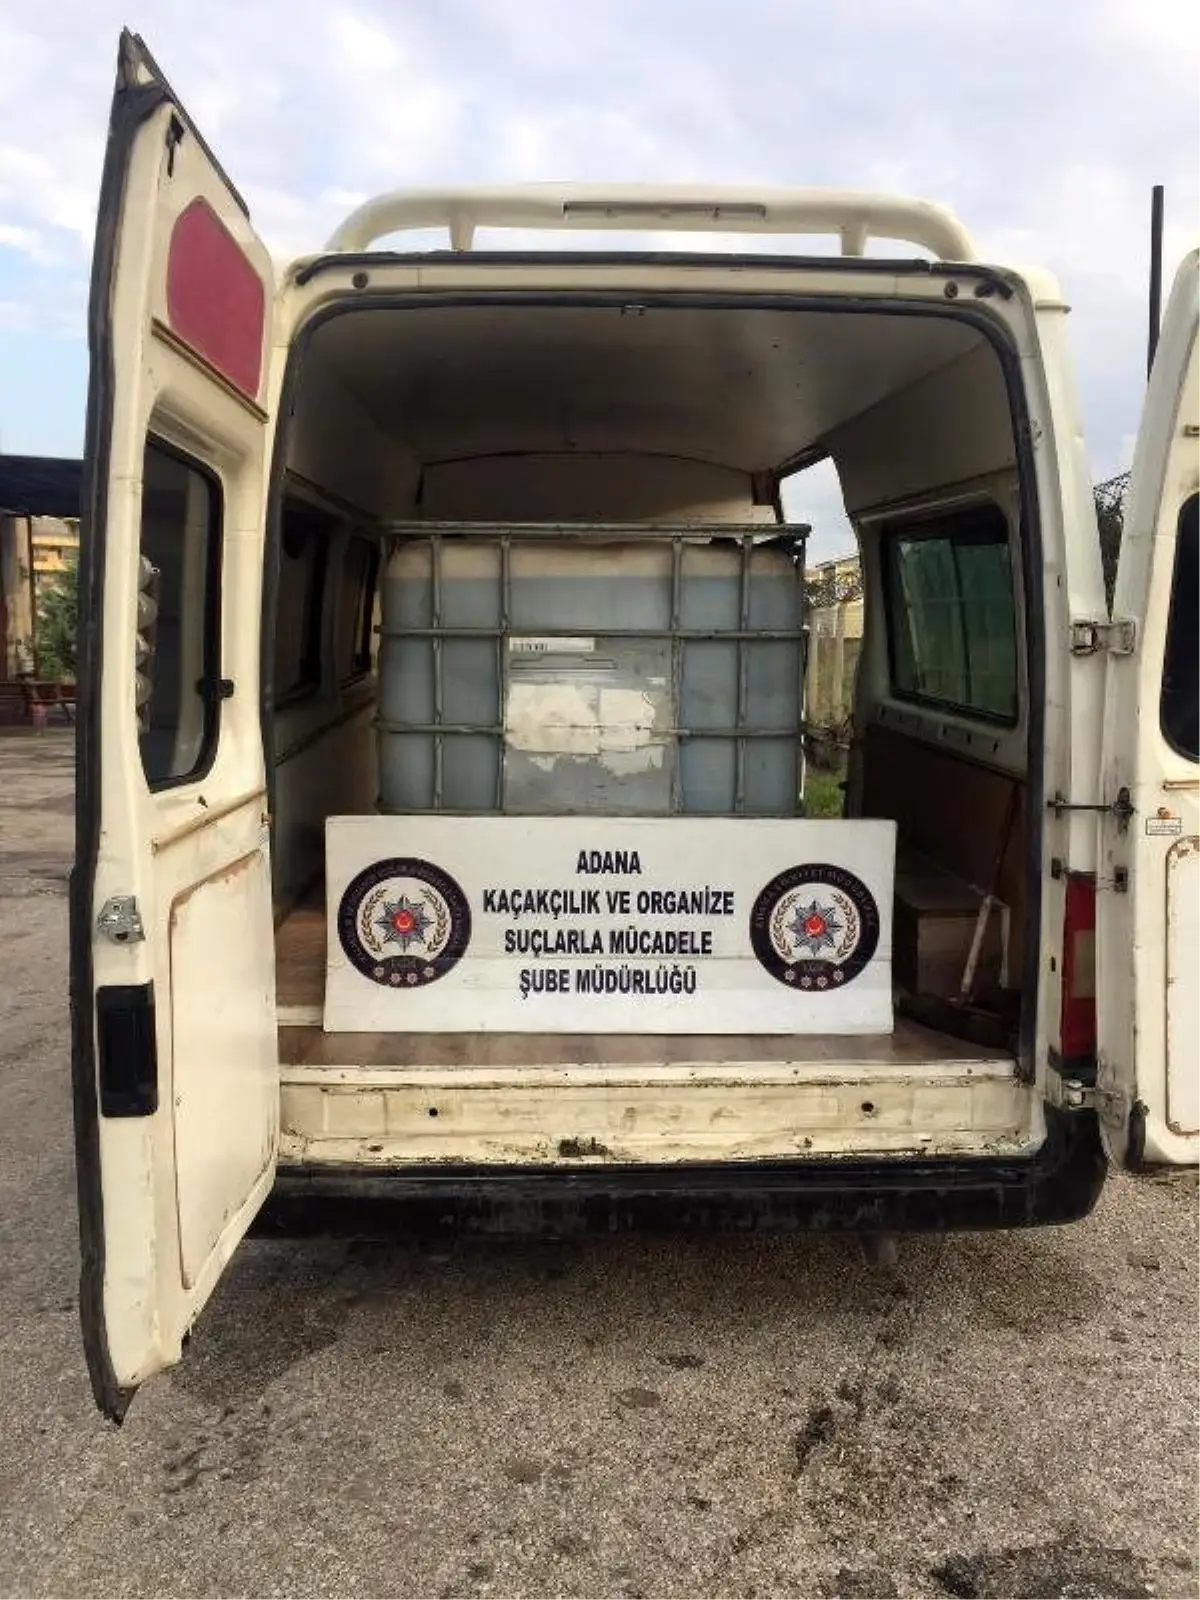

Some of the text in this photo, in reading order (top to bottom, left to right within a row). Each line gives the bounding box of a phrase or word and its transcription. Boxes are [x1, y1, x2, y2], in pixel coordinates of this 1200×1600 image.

[576, 851, 642, 874] ADANA
[483, 889, 600, 919] KAÇAKÇILIK
[606, 891, 630, 914] VE
[637, 886, 735, 915] ORGANİZE
[504, 926, 712, 957] SUÇLARLA MÜCADELE
[519, 964, 696, 999] ŞUBE MÜDÜRLÜĞÜ
